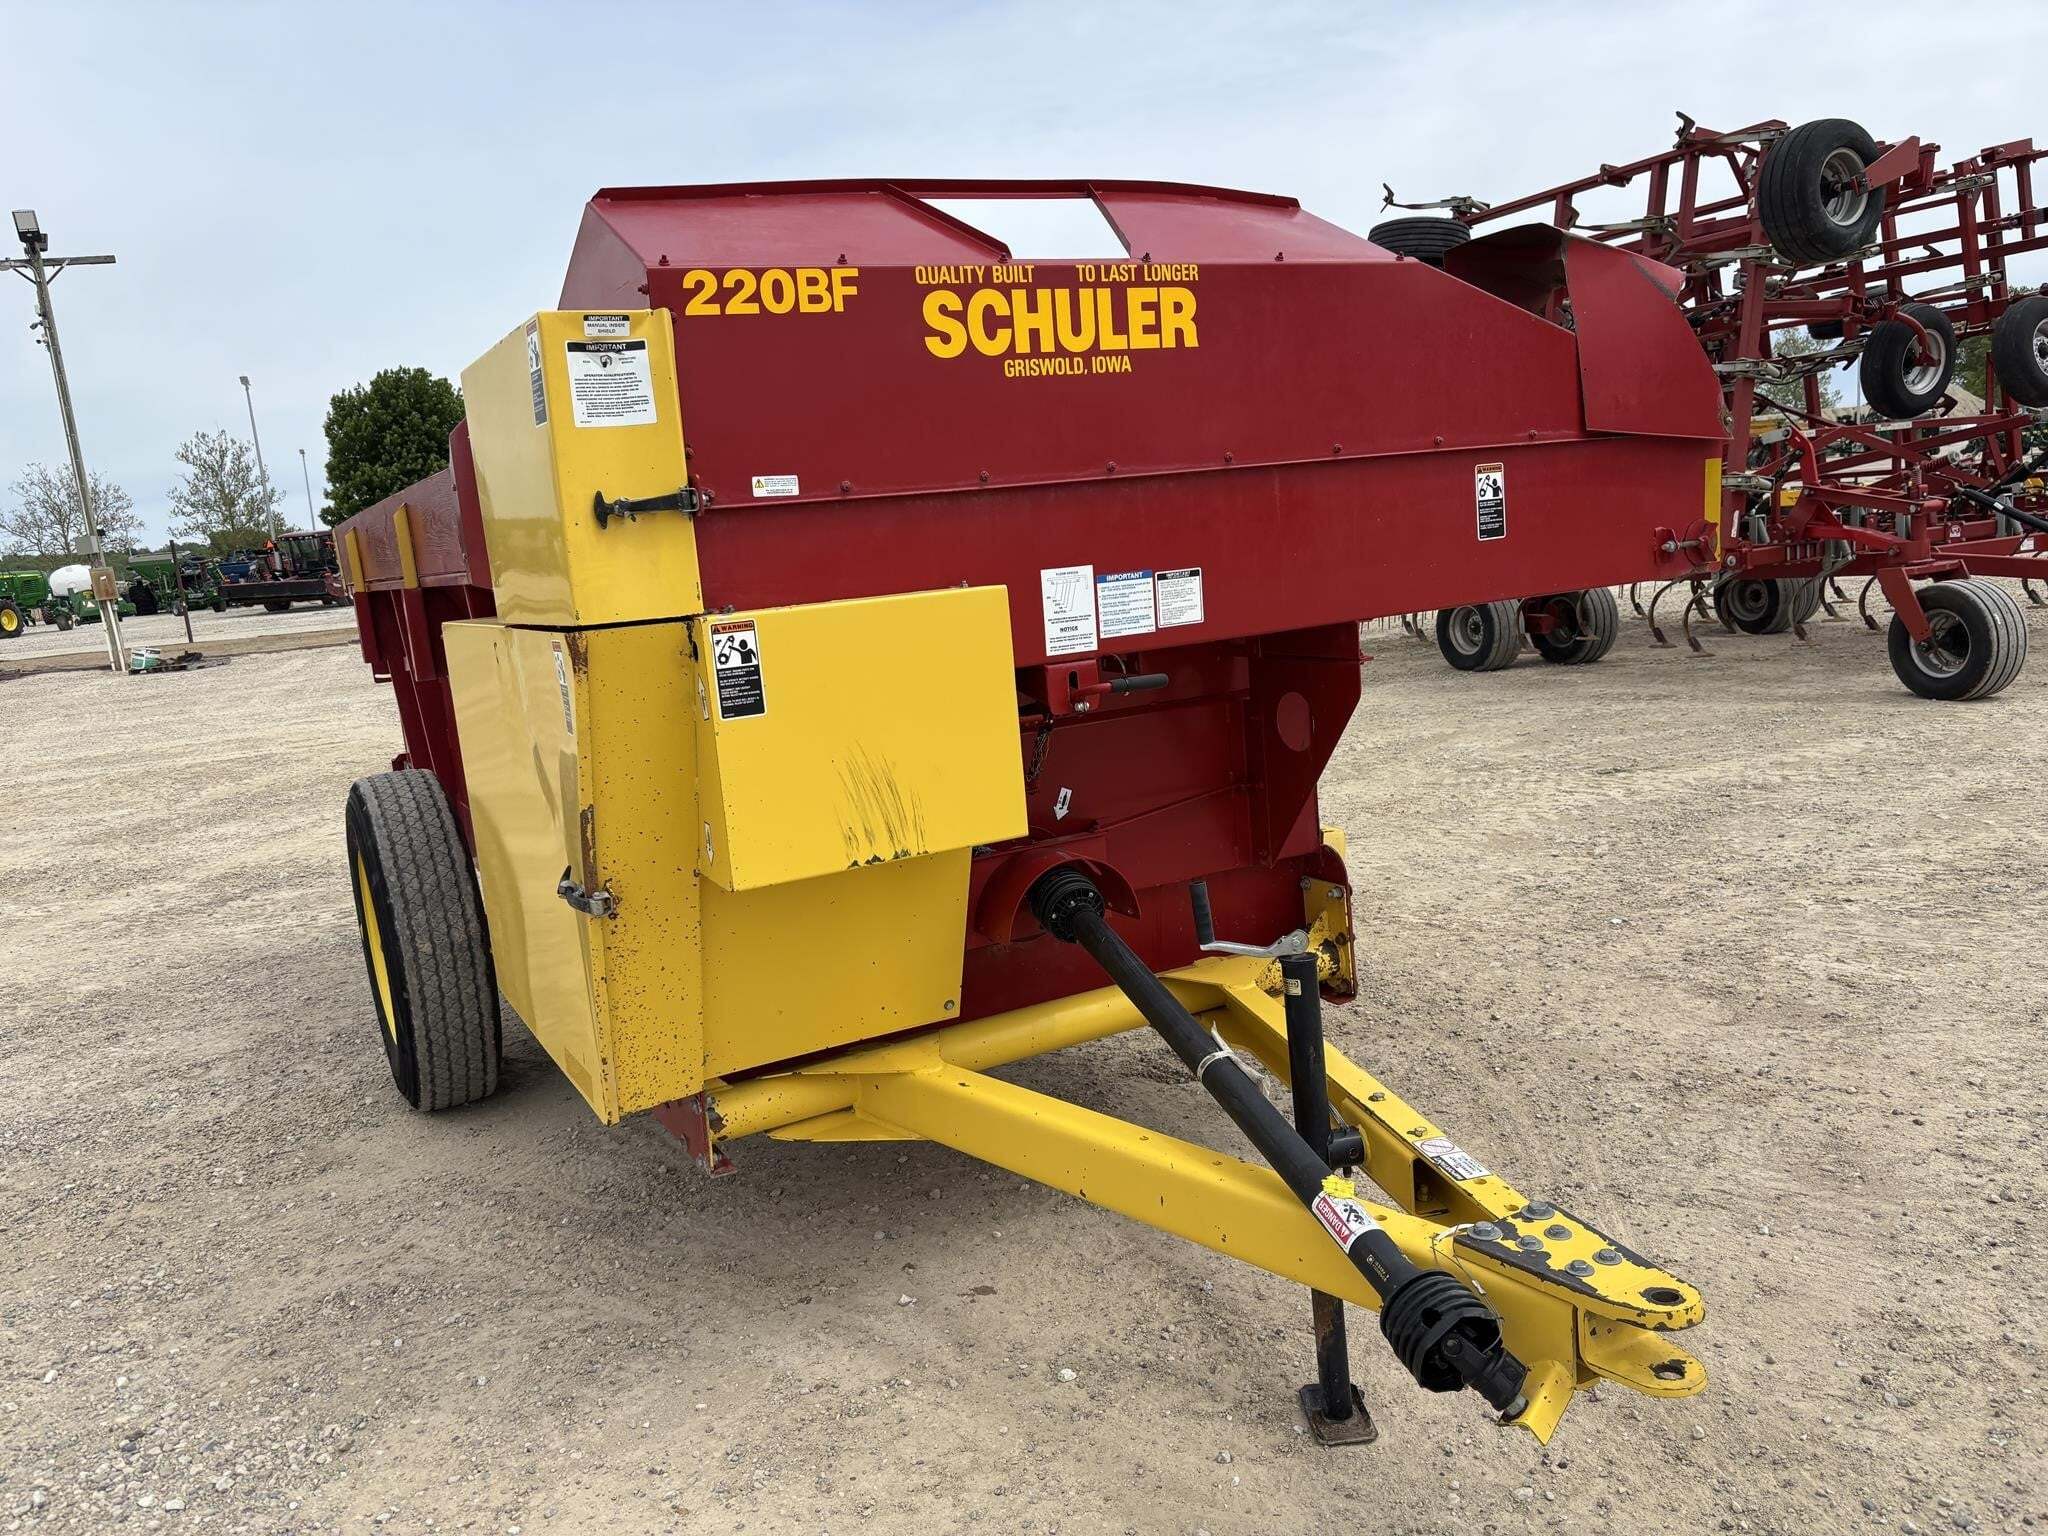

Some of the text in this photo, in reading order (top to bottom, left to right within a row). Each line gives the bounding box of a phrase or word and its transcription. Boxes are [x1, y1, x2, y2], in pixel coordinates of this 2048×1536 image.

[915, 264, 1034, 286] QUALITY BUILT
[1076, 262, 1199, 283] TO LAST LONGER
[682, 267, 859, 316] 220BF
[922, 286, 1199, 359] SCHULER
[1004, 355, 1132, 379] GRISWOLD, IOWA
[1107, 572, 1144, 581] IMPORTANT
[720, 623, 753, 632] WARNING
[1318, 1199, 1342, 1232] DANGER
